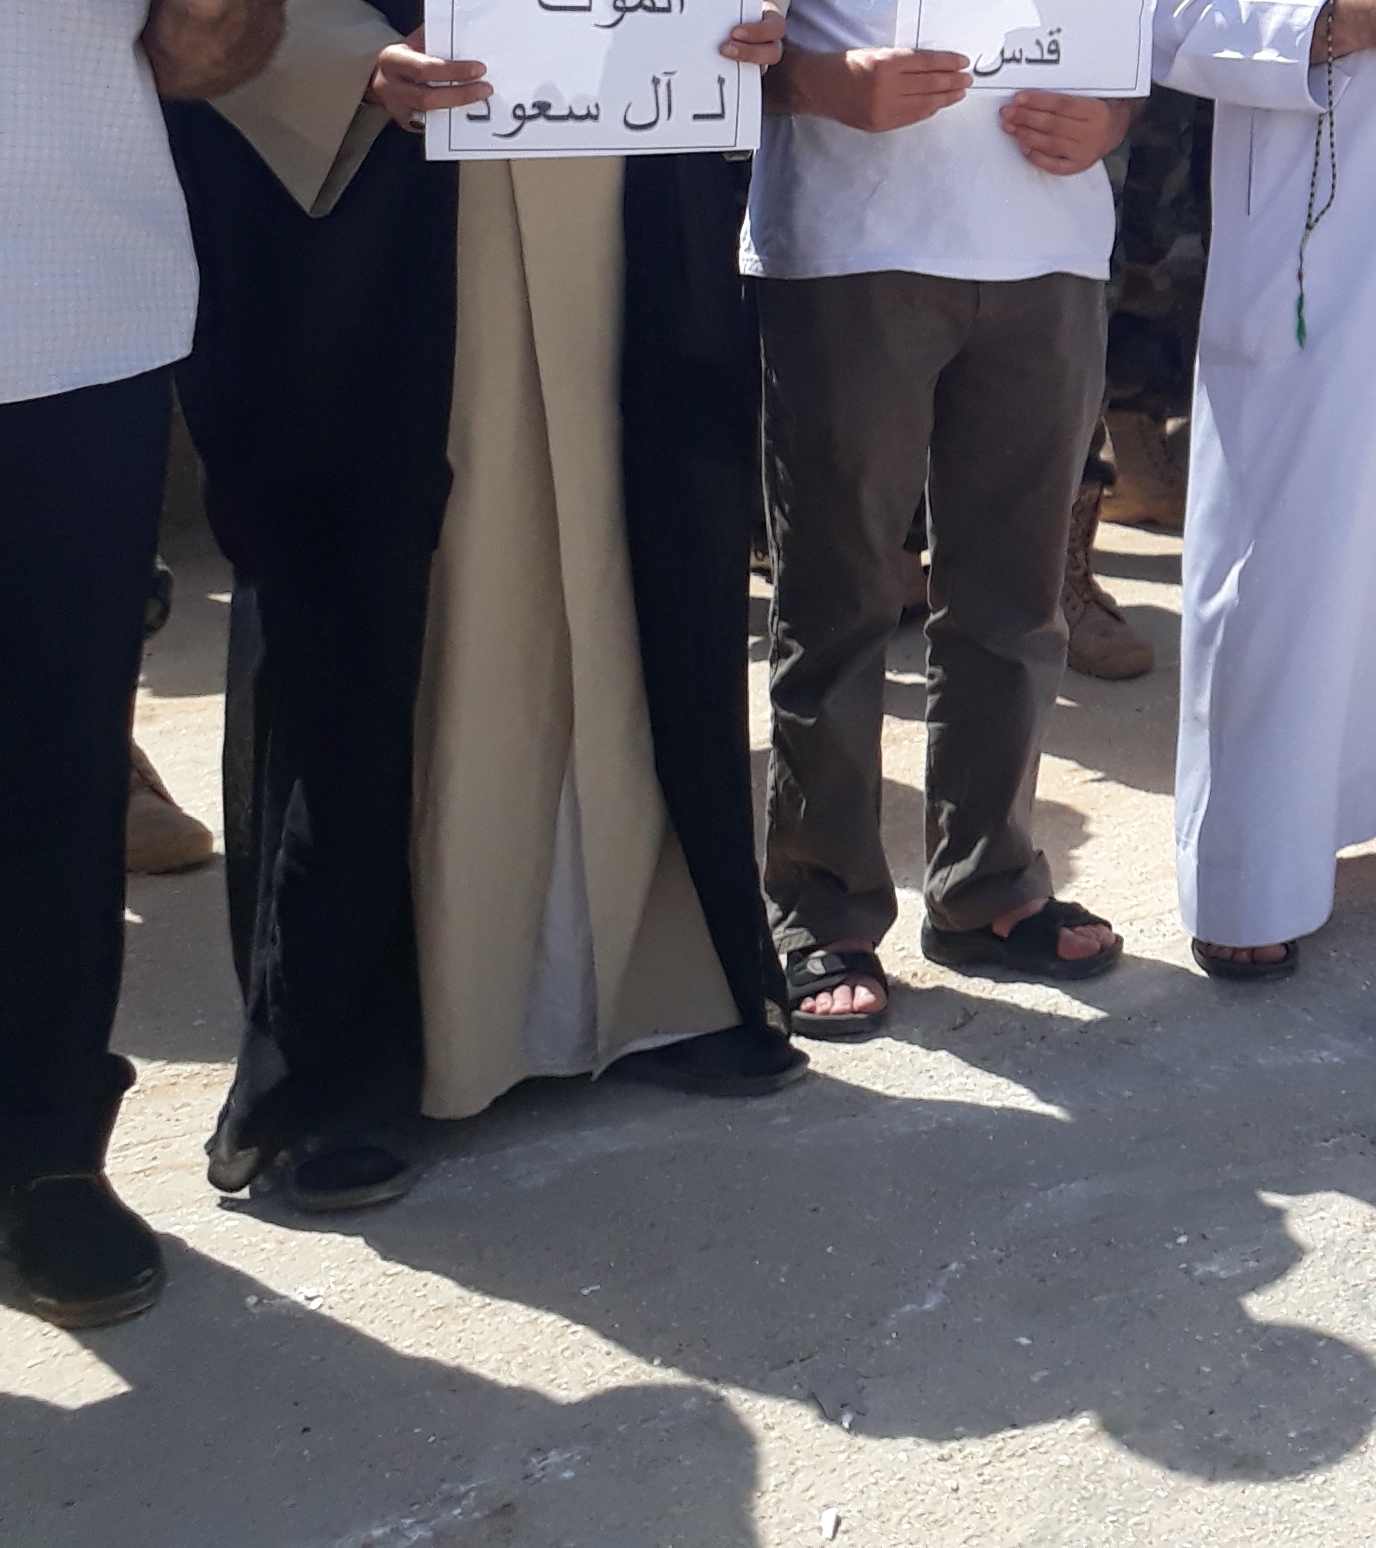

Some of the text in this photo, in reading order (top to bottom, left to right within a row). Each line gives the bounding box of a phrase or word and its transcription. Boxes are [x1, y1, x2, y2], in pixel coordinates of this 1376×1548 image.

[972, 27, 1062, 77] قدس
[465, 97, 600, 139] سعود
[623, 71, 678, 132] آل
